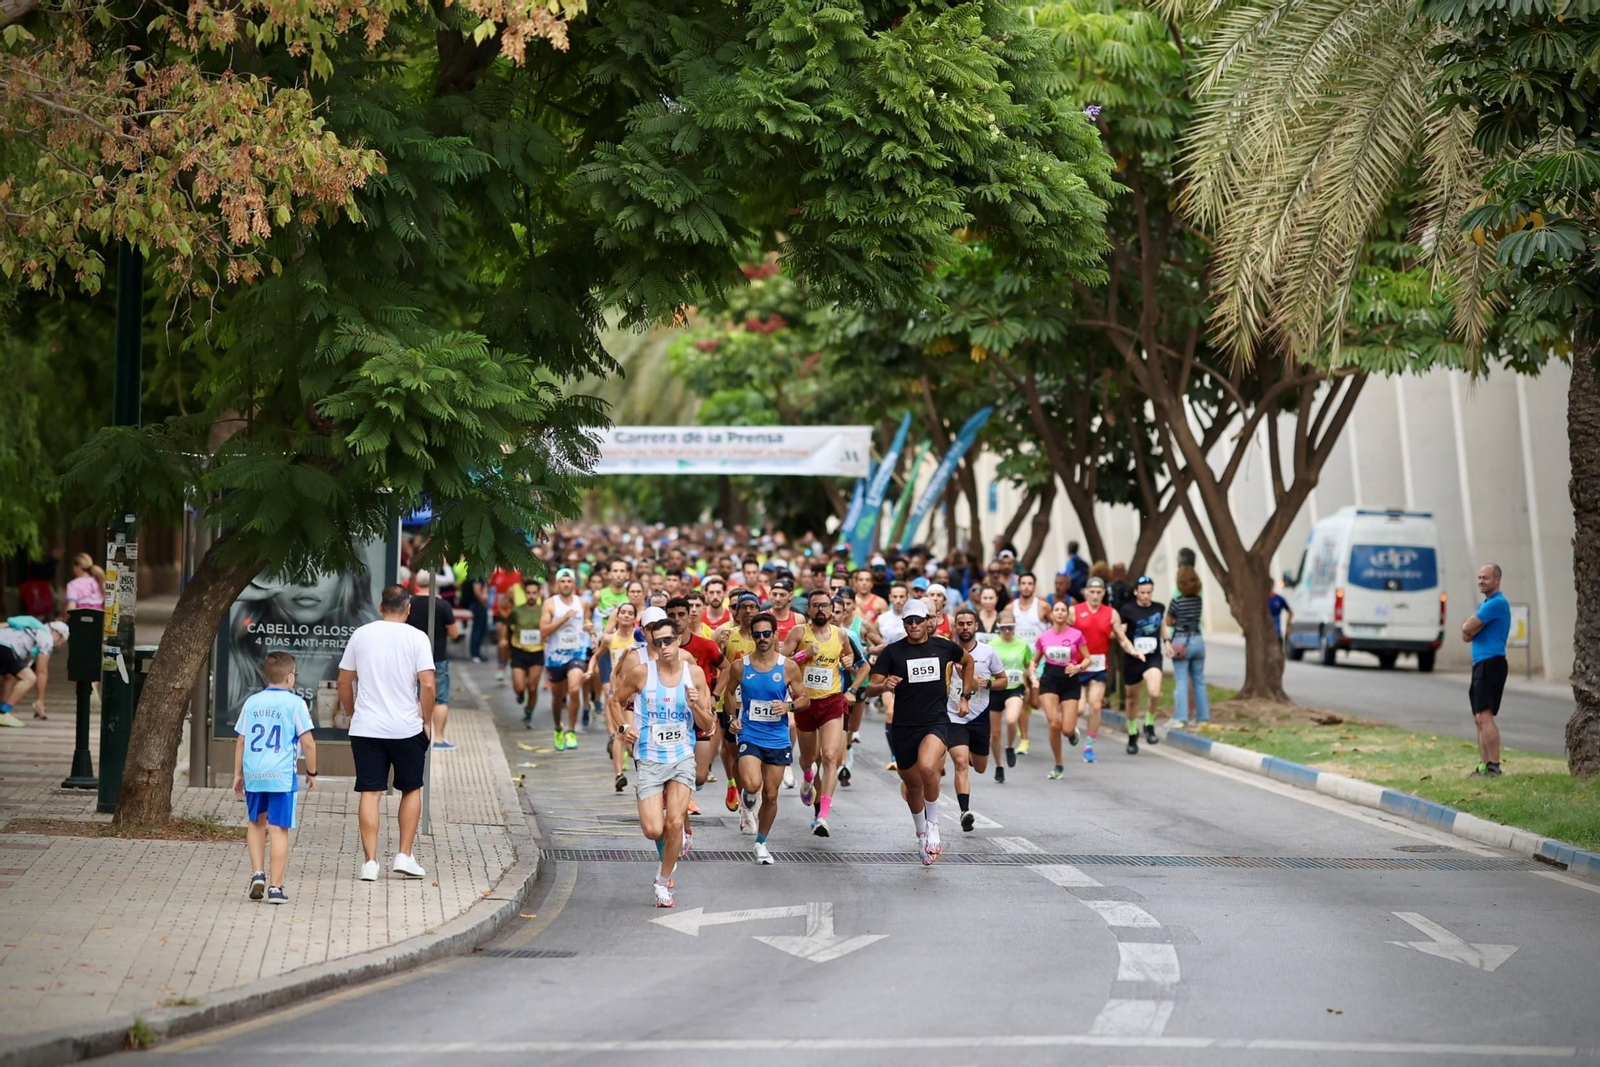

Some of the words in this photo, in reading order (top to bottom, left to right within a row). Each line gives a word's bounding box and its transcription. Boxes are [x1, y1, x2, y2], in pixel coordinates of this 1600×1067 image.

[614, 431, 677, 443] Carrera
[683, 431, 703, 443] de
[708, 432, 722, 443] la
[727, 431, 784, 443] Prensa
[247, 623, 309, 635] CABELLO
[313, 625, 360, 637] GLOSS
[255, 637, 262, 645] 4
[265, 635, 290, 646] DÍAS
[912, 665, 935, 676] 859
[807, 674, 828, 684] 692
[250, 723, 282, 754] 24
[657, 730, 682, 741] 125
